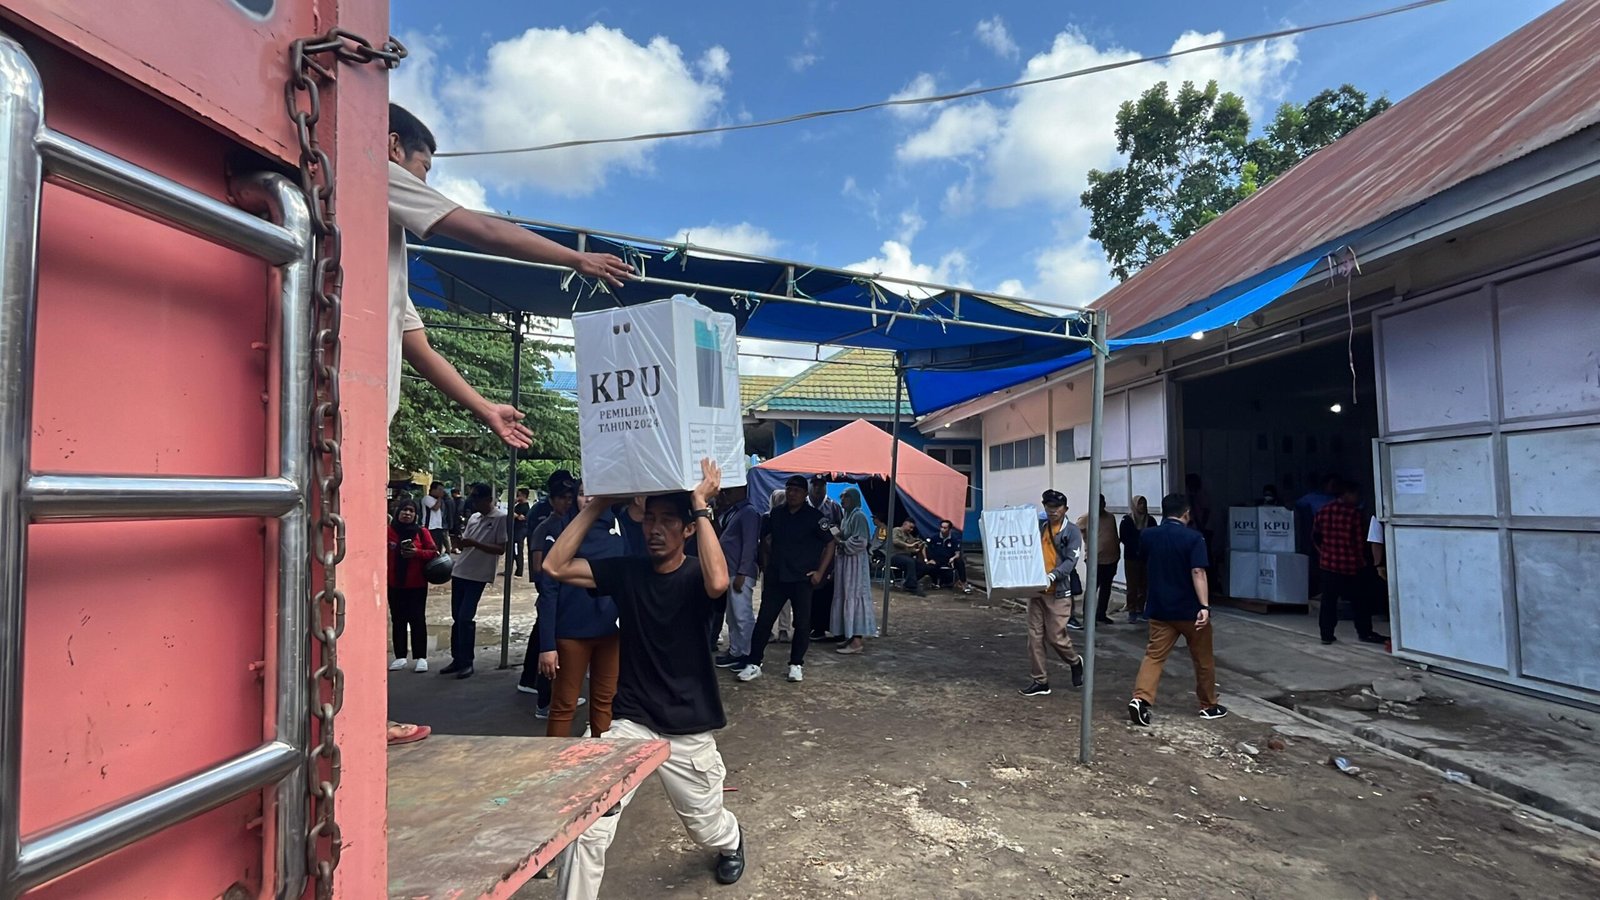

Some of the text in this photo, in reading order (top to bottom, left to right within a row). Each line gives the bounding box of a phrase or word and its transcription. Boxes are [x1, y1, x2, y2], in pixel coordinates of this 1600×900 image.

[590, 365, 661, 404] KPU
[599, 405, 656, 420] PEMILIHAN
[598, 418, 659, 433] TAHUN 2024
[1234, 521, 1257, 529] KPU
[1264, 521, 1290, 530] KPU
[994, 534, 1033, 549] KPU
